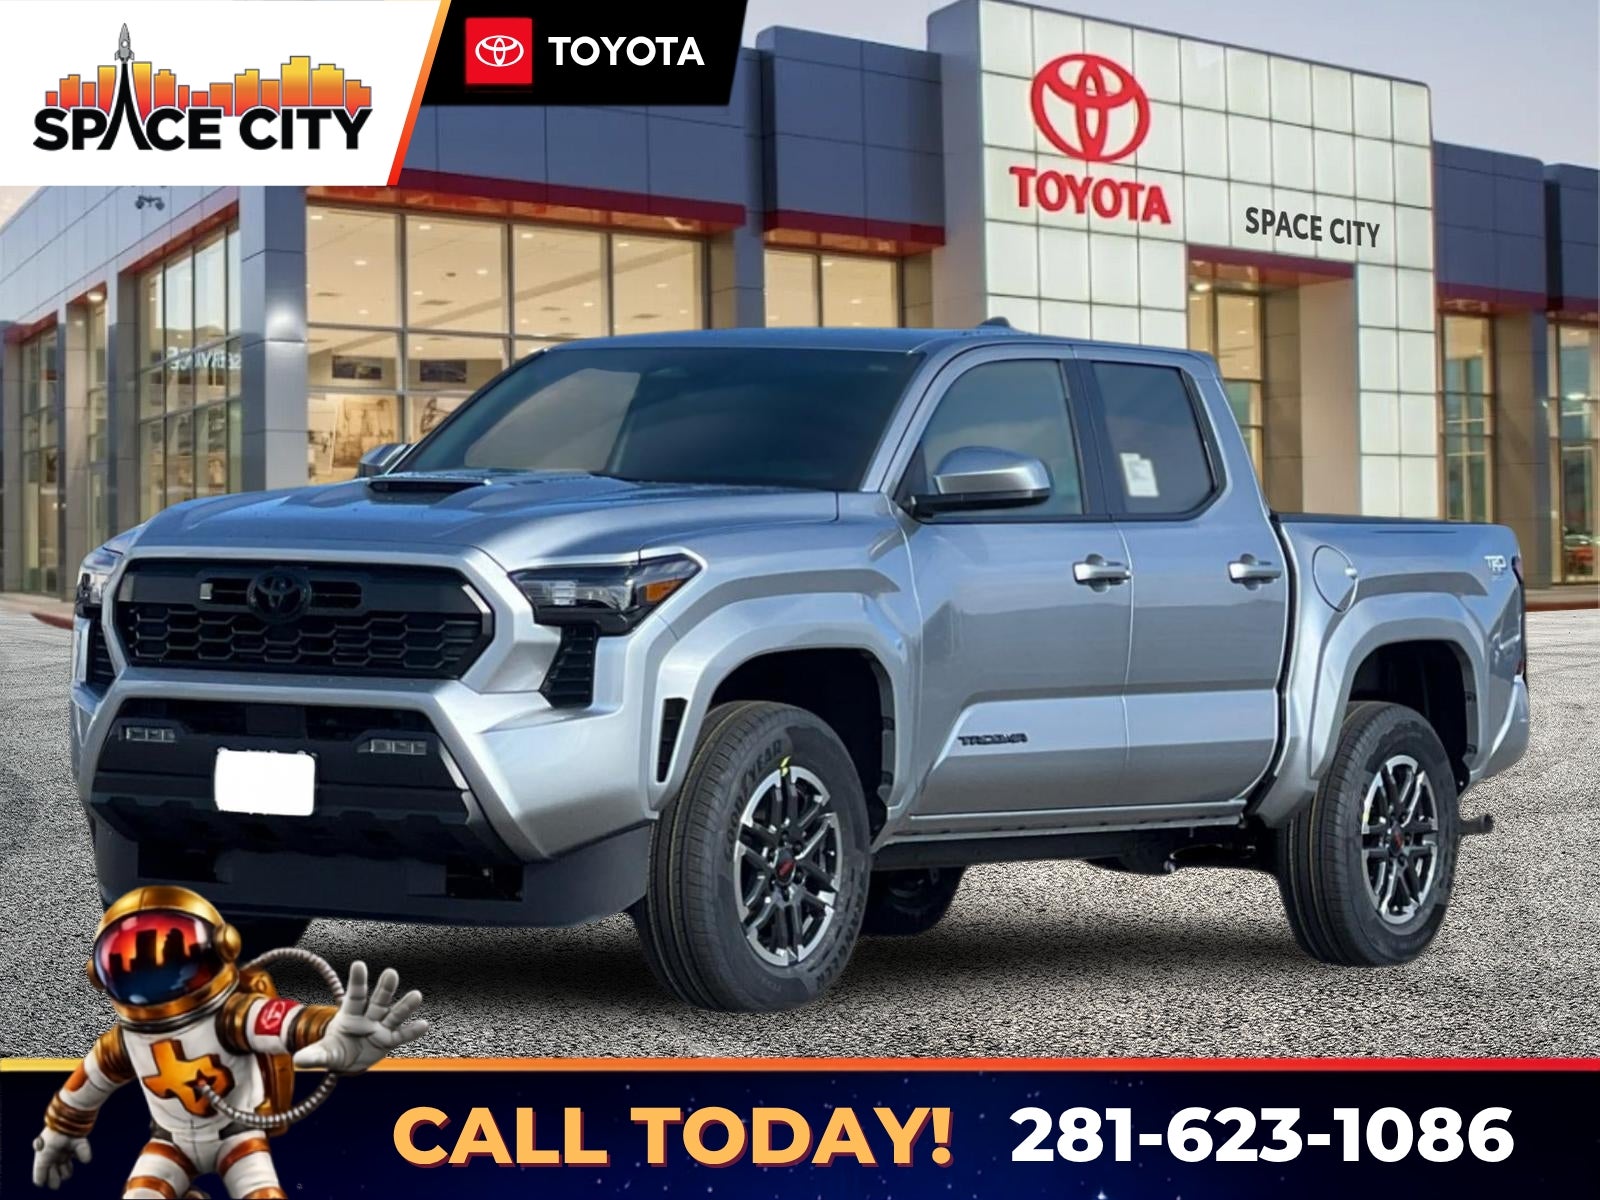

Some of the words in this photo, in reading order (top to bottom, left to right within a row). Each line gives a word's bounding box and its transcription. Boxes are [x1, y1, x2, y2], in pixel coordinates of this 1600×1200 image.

[1009, 165, 1171, 224] TOYOTA
[1245, 206, 1323, 242] SPACE
[1329, 218, 1381, 249] CITY
